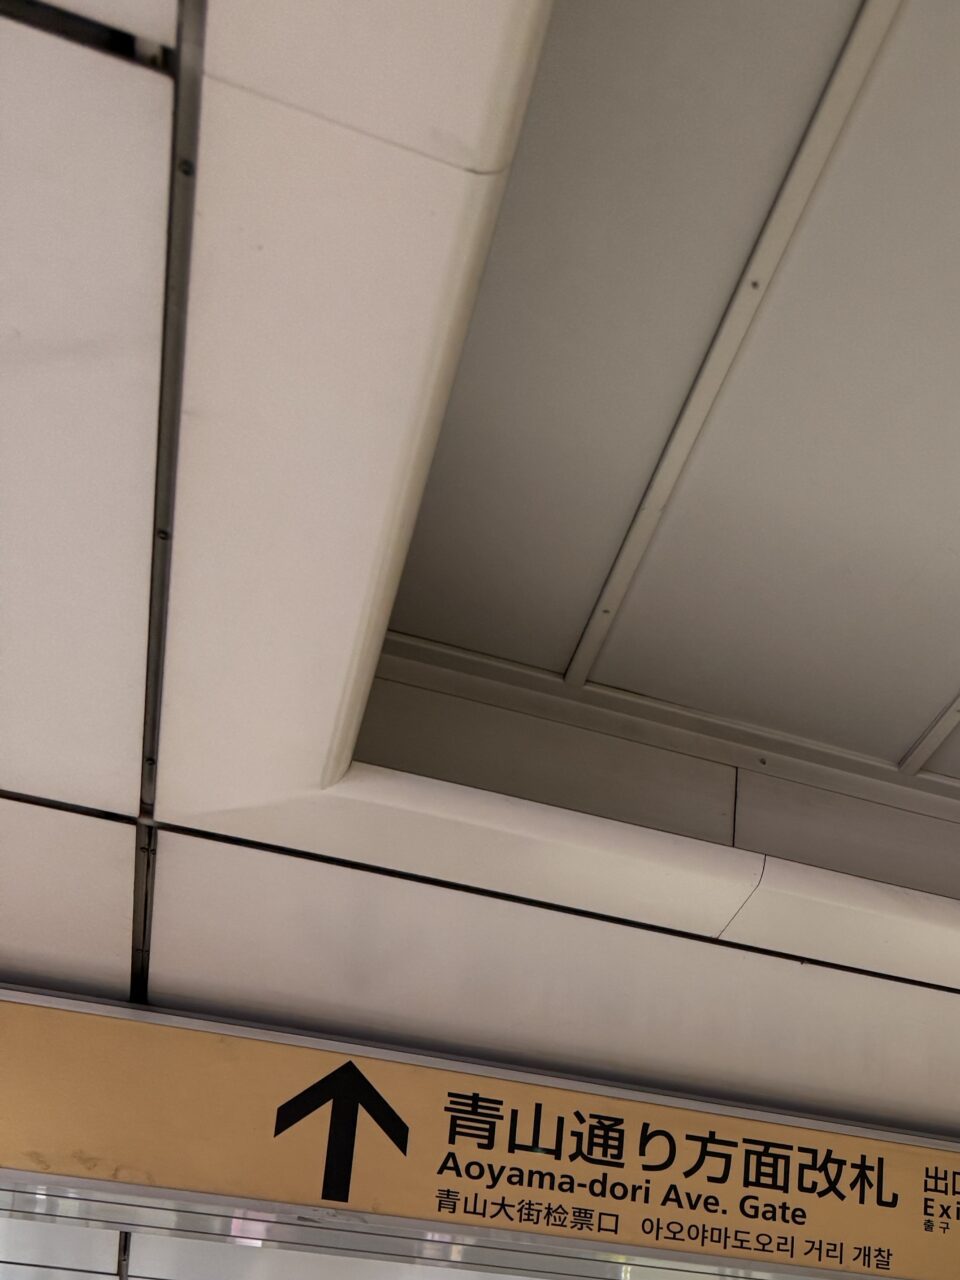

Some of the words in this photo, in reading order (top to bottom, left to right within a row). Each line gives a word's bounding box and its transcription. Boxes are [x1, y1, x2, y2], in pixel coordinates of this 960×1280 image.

[444, 1092, 899, 1208] 青山通り方面改札
[435, 1188, 620, 1235] 青山大街检票口
[437, 1151, 651, 1205] Aoyama-dori
[660, 1184, 728, 1216] Ave.
[738, 1196, 808, 1226] Gate
[640, 1217, 795, 1258] 아오야마도오리
[802, 1240, 844, 1265] 거리
[852, 1246, 893, 1270] 개찰
[923, 1219, 950, 1234] 출구
